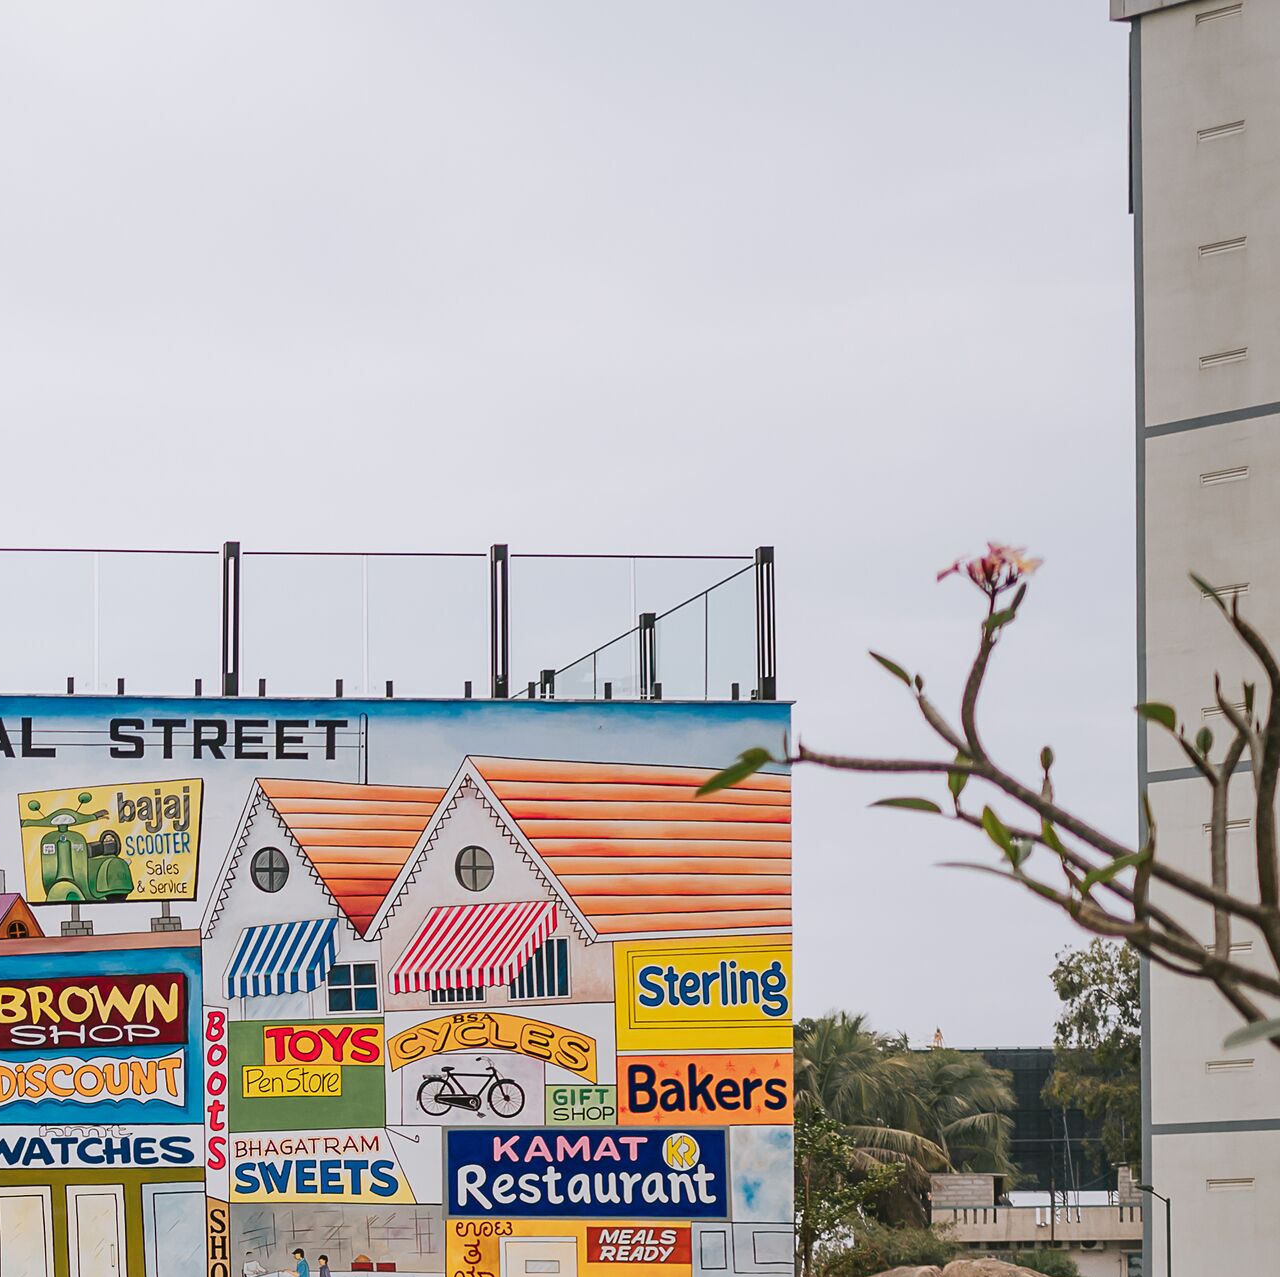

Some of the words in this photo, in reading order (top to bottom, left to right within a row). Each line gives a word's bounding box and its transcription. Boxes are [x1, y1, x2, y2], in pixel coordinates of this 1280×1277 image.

[110, 718, 348, 760] STREET
[117, 786, 190, 833] bajaj
[125, 832, 190, 856] SCOOTER
[146, 859, 179, 875] Sales
[137, 880, 145, 893] &
[638, 960, 788, 1017] Sterling
[452, 1014, 495, 1024] BSA
[10, 1024, 160, 1045] SHOP
[265, 1027, 380, 1063] TOYS
[394, 1021, 590, 1072] CYCLES
[552, 1088, 610, 1106] GIFT
[627, 1063, 787, 1114] Bakers
[553, 1106, 615, 1121] SHOP
[235, 1135, 380, 1158] BHAGATRAM
[493, 1135, 649, 1163] KAMAT
[234, 1159, 399, 1197] SWEETS
[457, 1163, 717, 1210] Restaurant
[456, 1221, 513, 1237] ಊಟ
[598, 1229, 677, 1245] MEALS
[599, 1245, 675, 1262] READY
